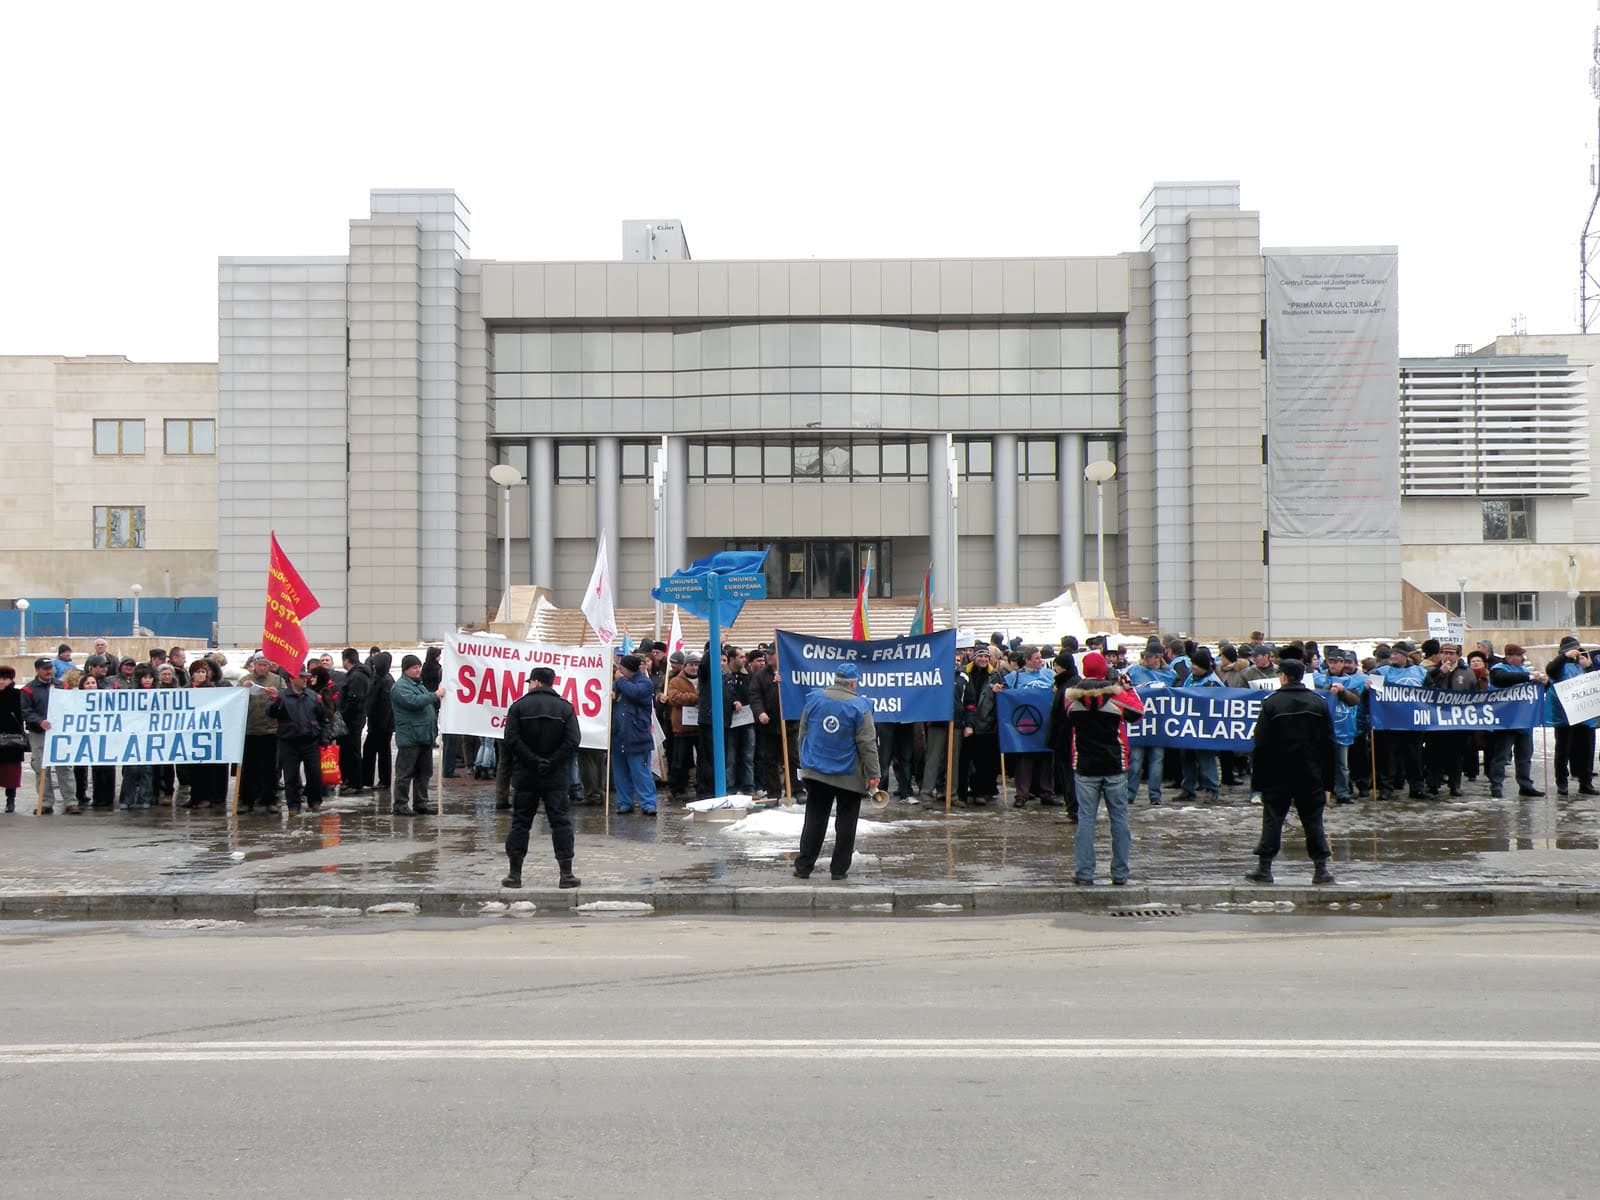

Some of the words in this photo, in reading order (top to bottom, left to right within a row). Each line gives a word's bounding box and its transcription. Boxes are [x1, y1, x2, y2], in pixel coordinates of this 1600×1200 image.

[457, 642, 520, 661] UNIUNEA
[803, 643, 857, 660] CNSLR
[792, 670, 835, 686] UNIUN
[86, 691, 196, 711] SINDICATUL
[456, 665, 602, 717] SANAS
[1375, 686, 1434, 703] SINDICATUL
[1143, 697, 1200, 716] ATUL
[1208, 699, 1262, 719] LIBE
[1414, 709, 1431, 725] DIN
[1437, 705, 1500, 726] L.P.G.S.
[63, 713, 122, 733] POSTA
[1127, 718, 1157, 737] EH
[1164, 718, 1257, 740] CALARA
